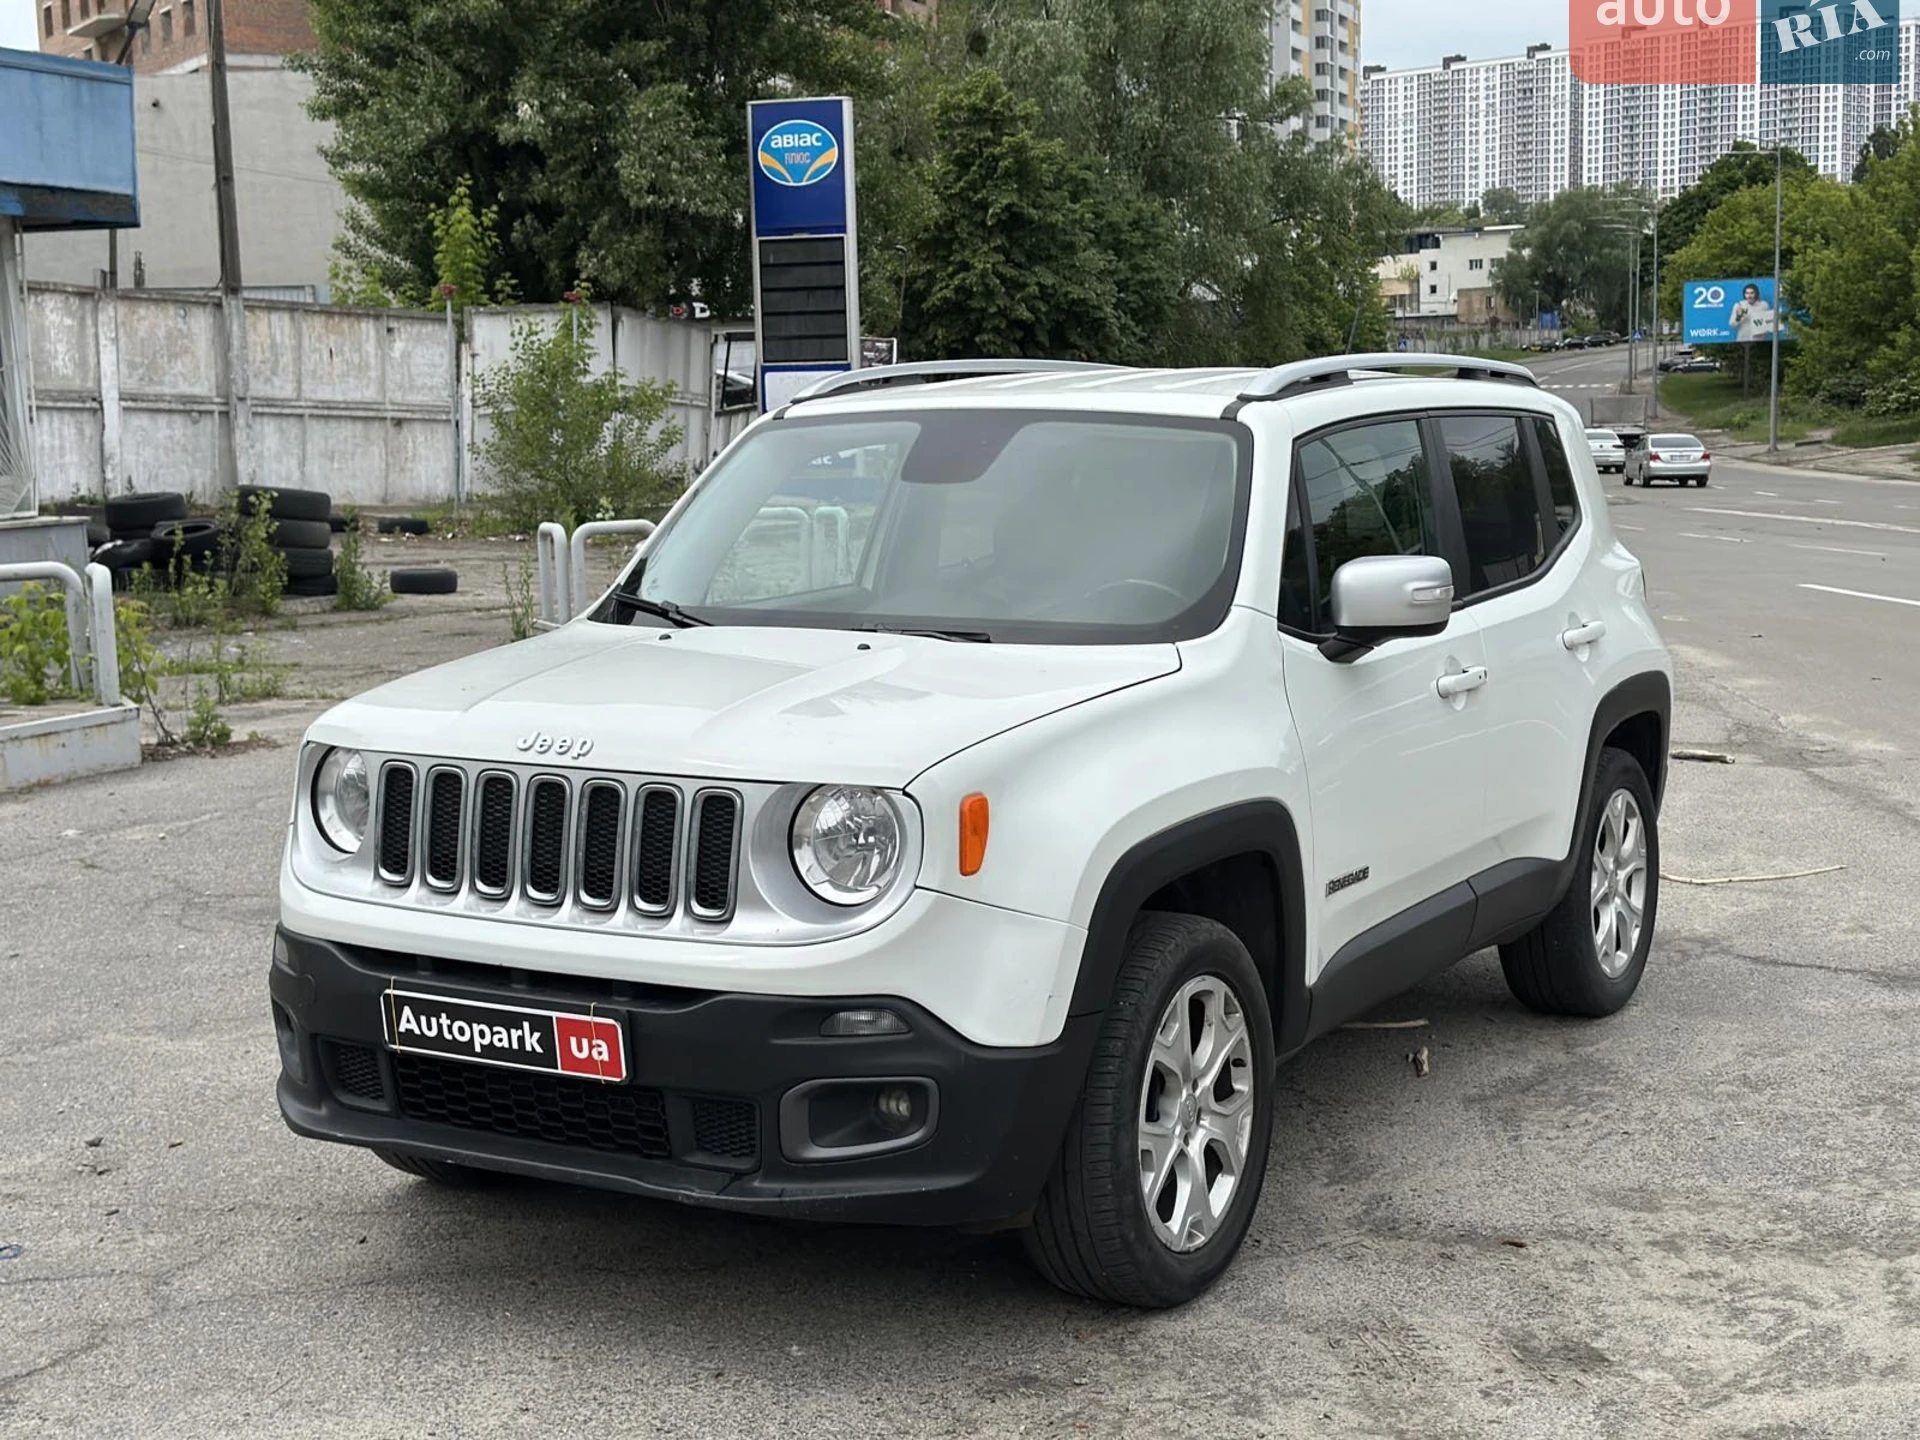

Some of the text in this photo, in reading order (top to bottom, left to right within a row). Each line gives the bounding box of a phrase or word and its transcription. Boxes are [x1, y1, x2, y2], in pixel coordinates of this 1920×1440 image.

[1693, 286, 1726, 308] 20
[517, 729, 594, 760] Jeep
[398, 1005, 610, 1062] Autopark ua
